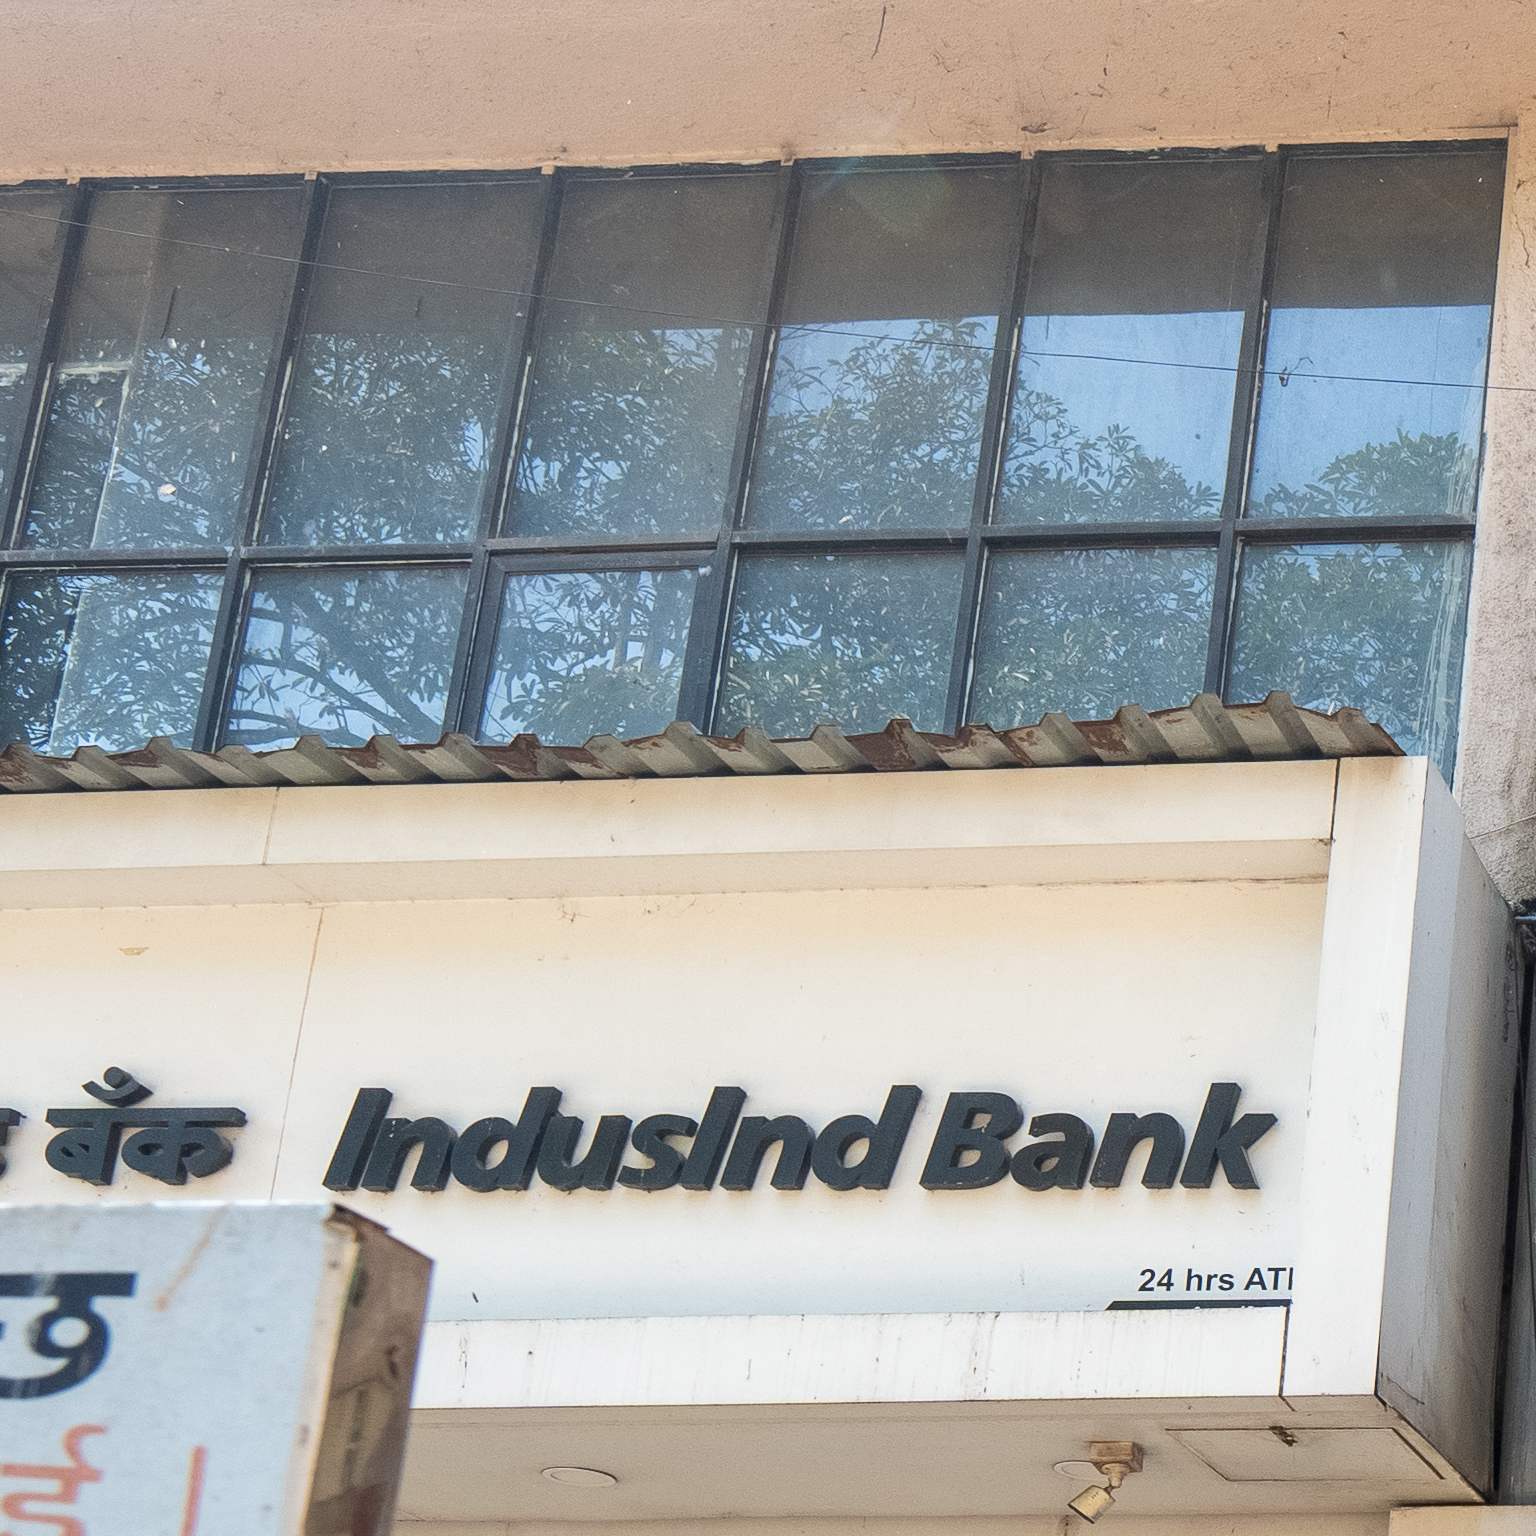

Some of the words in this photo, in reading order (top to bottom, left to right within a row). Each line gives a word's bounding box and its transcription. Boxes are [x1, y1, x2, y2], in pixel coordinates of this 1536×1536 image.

[45, 1066, 247, 1185] बँक
[322, 1084, 924, 1193] IndusInd
[919, 1082, 1278, 1190] Bank
[1138, 1268, 1174, 1291] 24
[1185, 1268, 1235, 1291] hrs
[1244, 1267, 1294, 1290] AT
